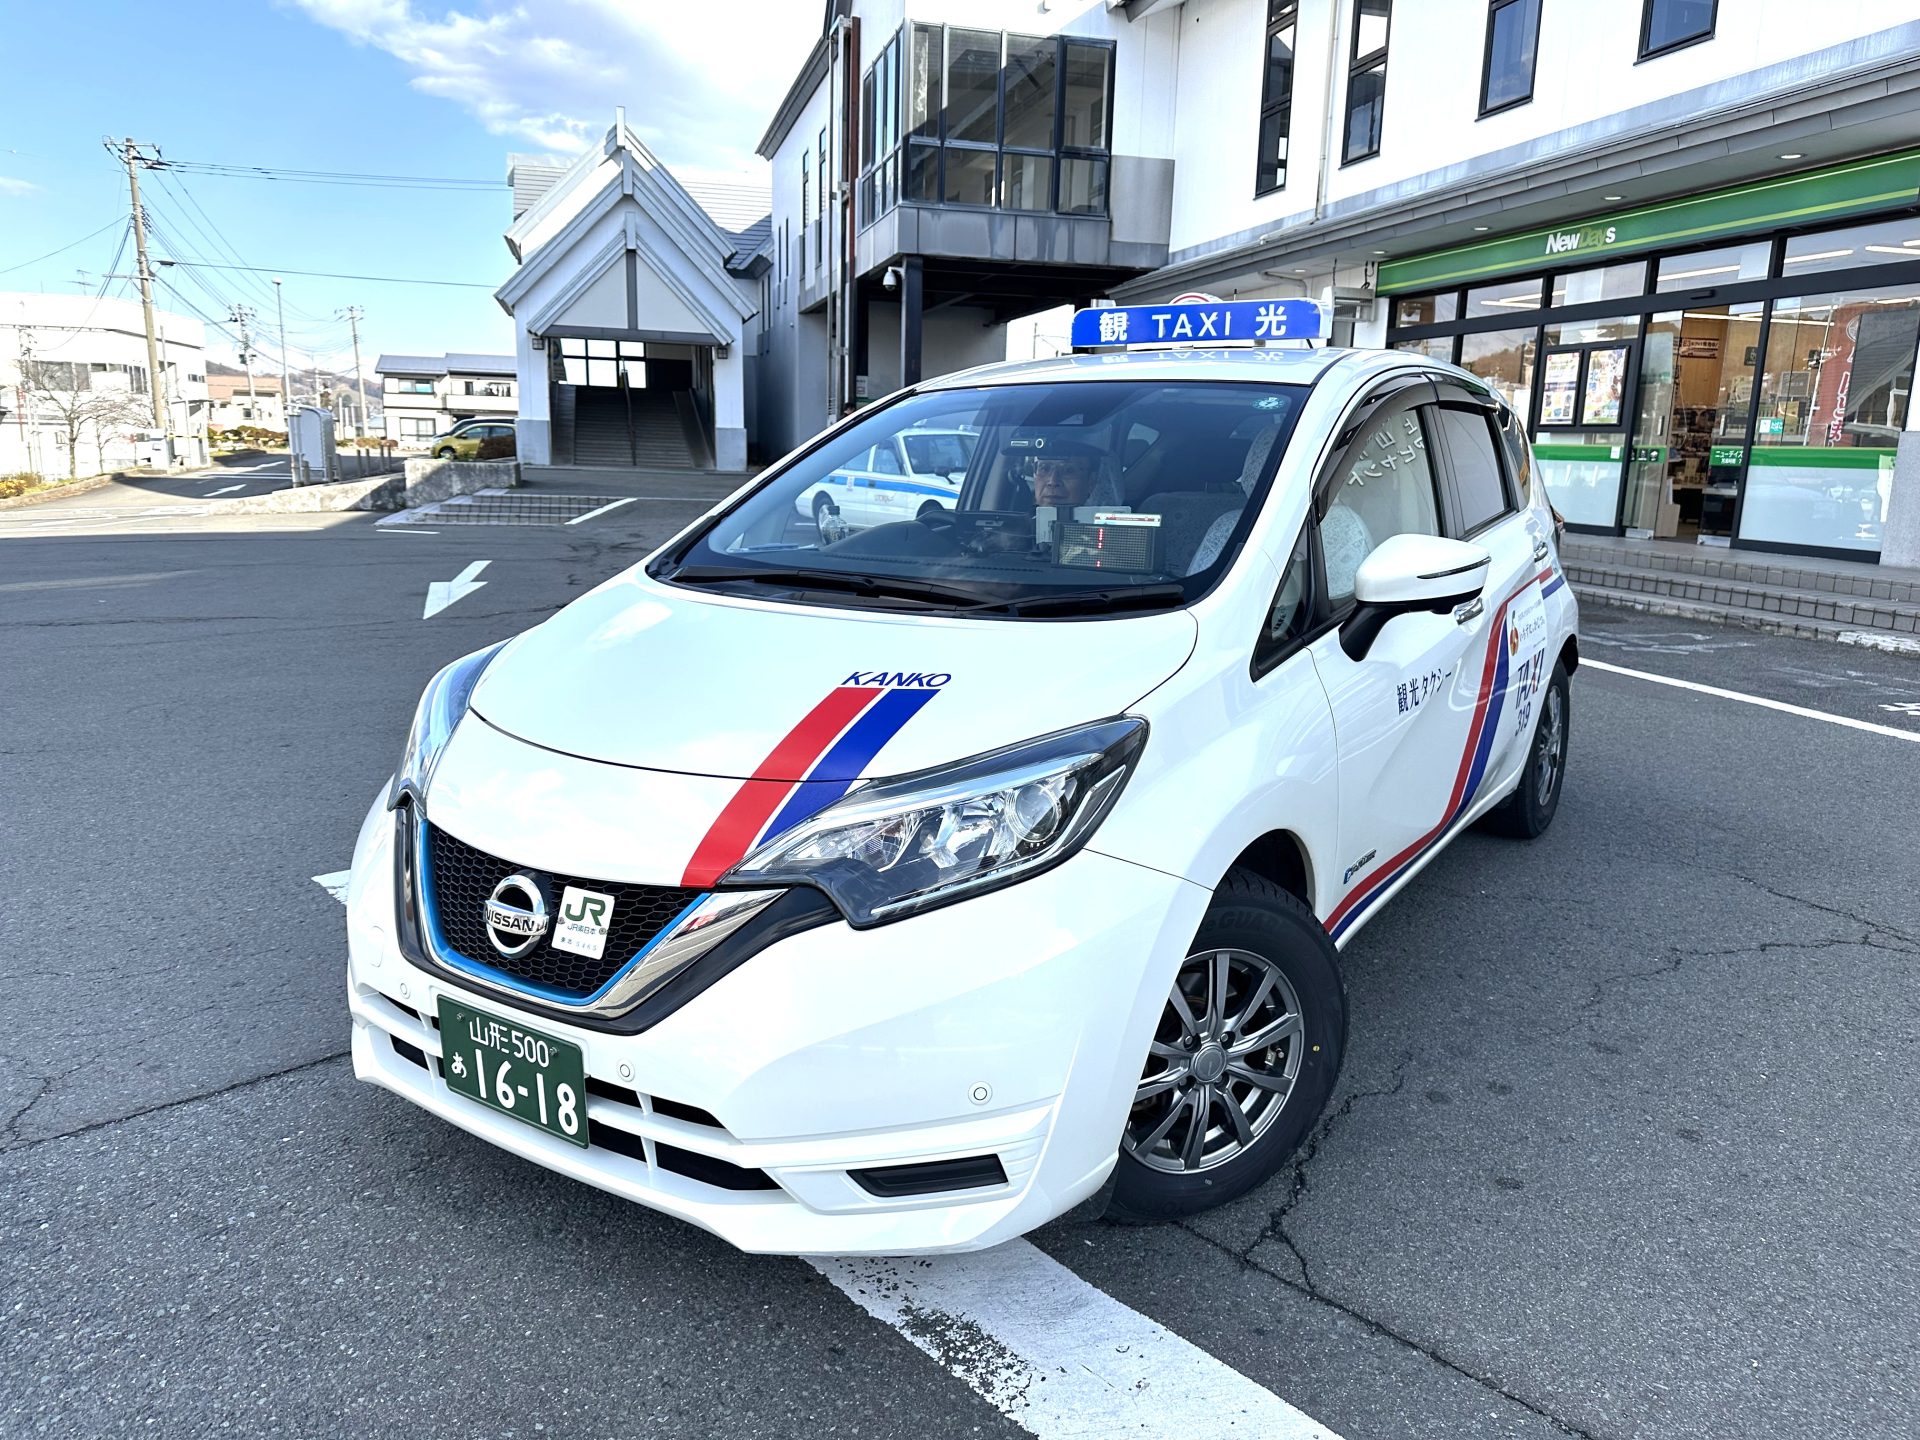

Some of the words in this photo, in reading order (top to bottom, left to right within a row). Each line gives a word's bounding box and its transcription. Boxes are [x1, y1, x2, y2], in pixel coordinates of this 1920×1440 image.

[1545, 227, 1616, 254] NewDays
[1099, 311, 1128, 342] 観
[1151, 311, 1231, 338] TAXI
[1255, 304, 1287, 337] 光
[841, 671, 952, 687] KANKO
[1397, 668, 1452, 715] 観光タクシー
[1515, 648, 1545, 709] TAXI
[1514, 701, 1531, 736] 319
[485, 906, 534, 932] NISSAN
[565, 896, 607, 927] JR
[469, 1017, 510, 1054] 山形
[511, 1030, 549, 1068] 500
[451, 1052, 467, 1078] あ
[475, 1049, 579, 1136] 16-18
